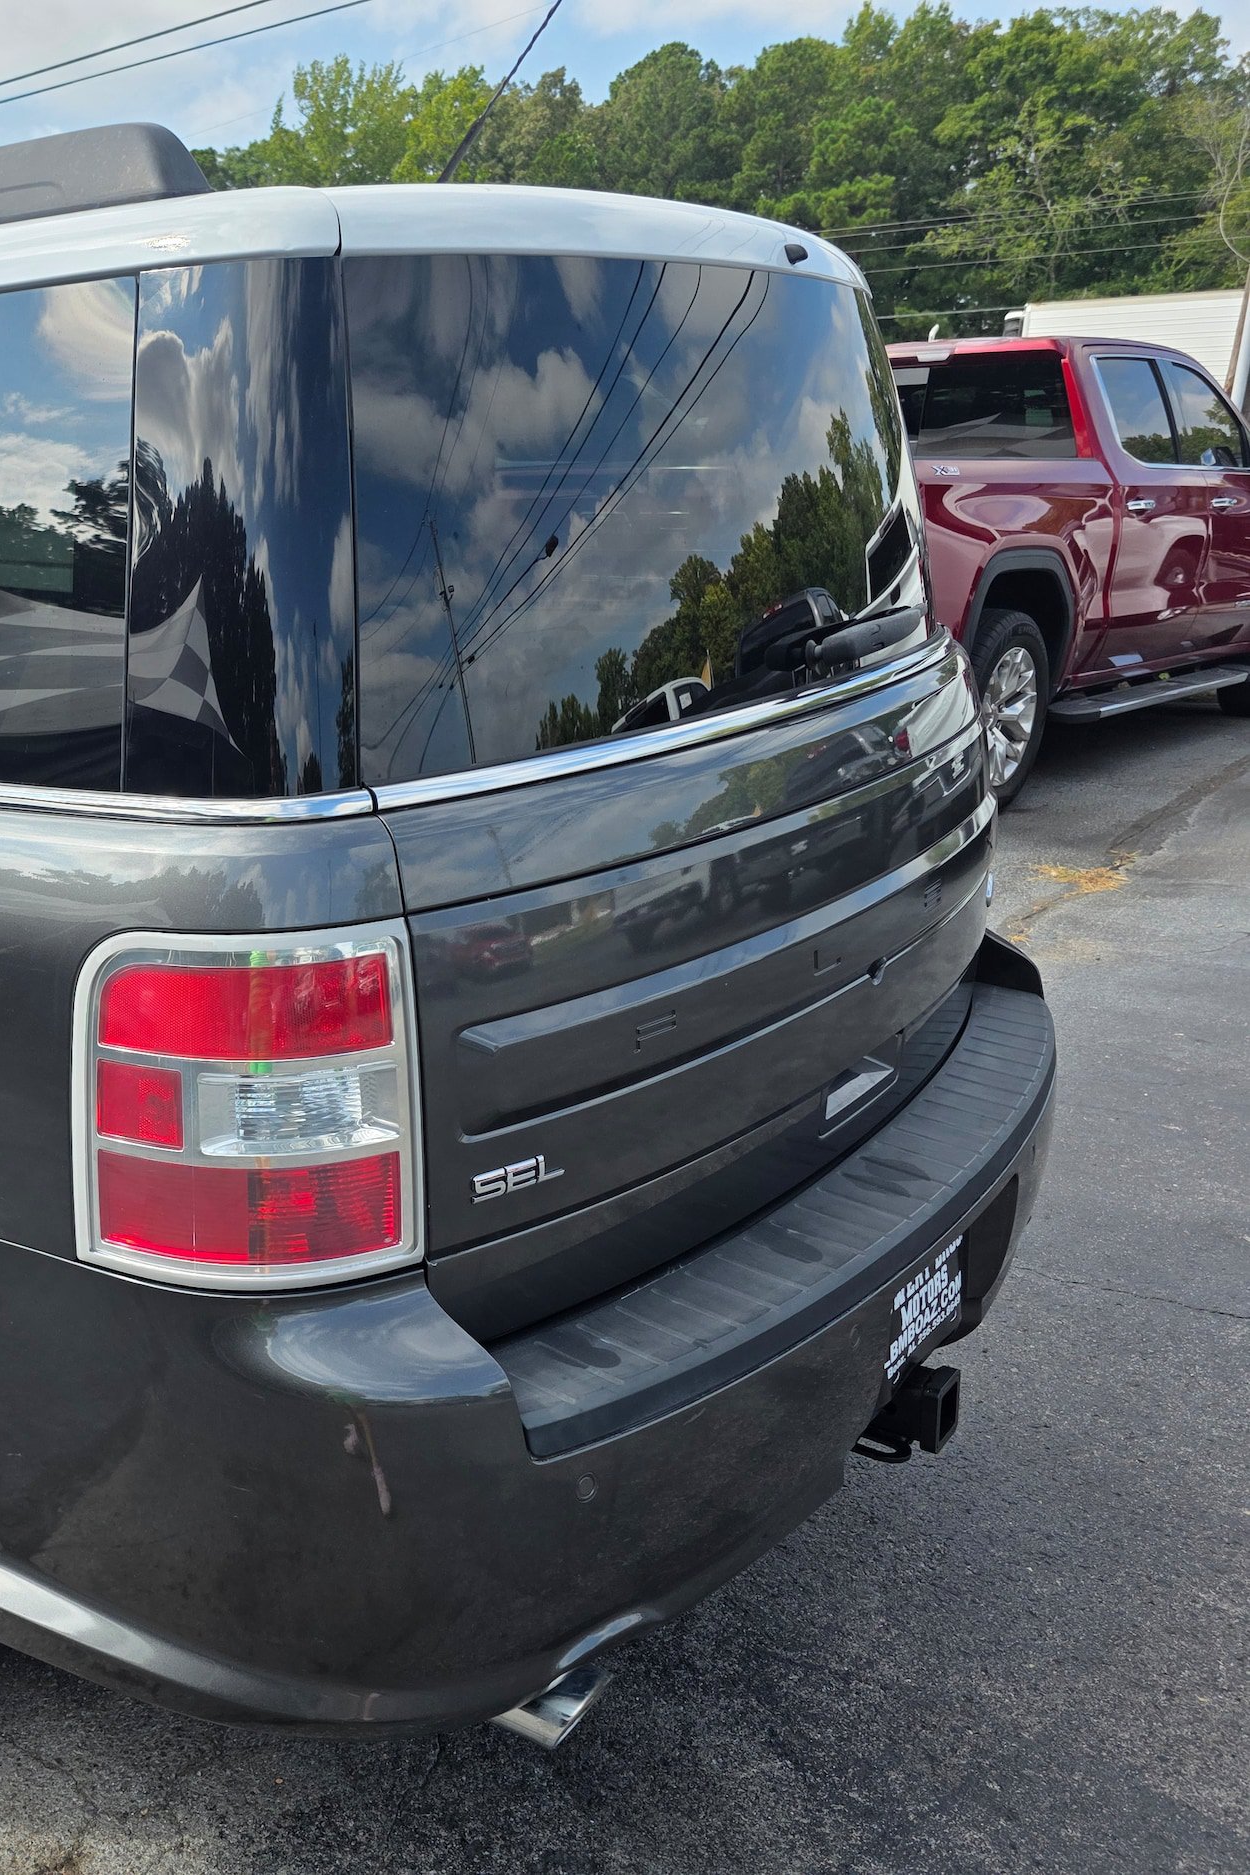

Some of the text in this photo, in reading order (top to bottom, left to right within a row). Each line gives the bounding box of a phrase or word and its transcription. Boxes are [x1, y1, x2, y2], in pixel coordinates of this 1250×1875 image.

[471, 1154, 566, 1204] SEL
[890, 1270, 962, 1363] BMBOAZ.COM
[900, 1263, 948, 1331] MOTORS
[907, 1343, 917, 1358] AL
